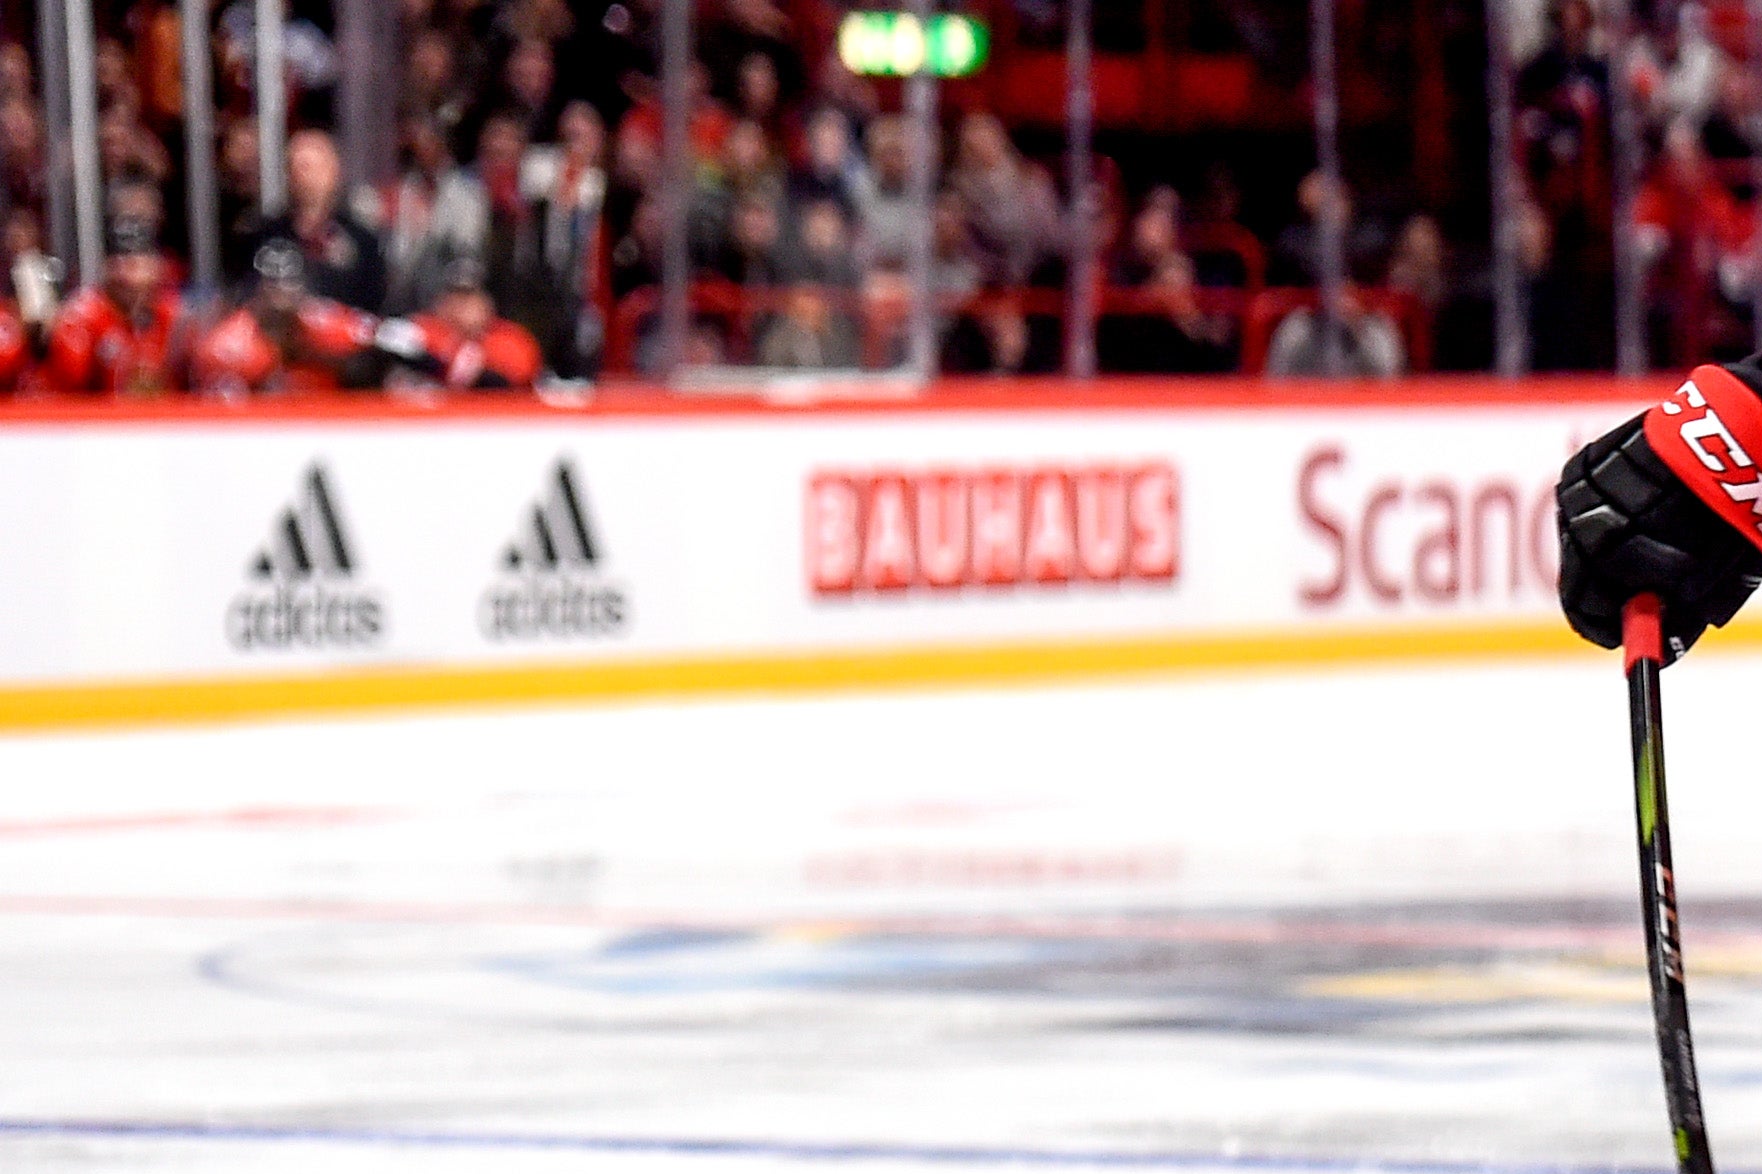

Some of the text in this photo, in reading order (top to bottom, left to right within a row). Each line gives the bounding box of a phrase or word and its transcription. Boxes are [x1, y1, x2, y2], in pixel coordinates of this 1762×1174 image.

[812, 468, 1178, 592] BAUHAUS
[226, 584, 386, 650] adidas
[476, 578, 633, 640] adidas
